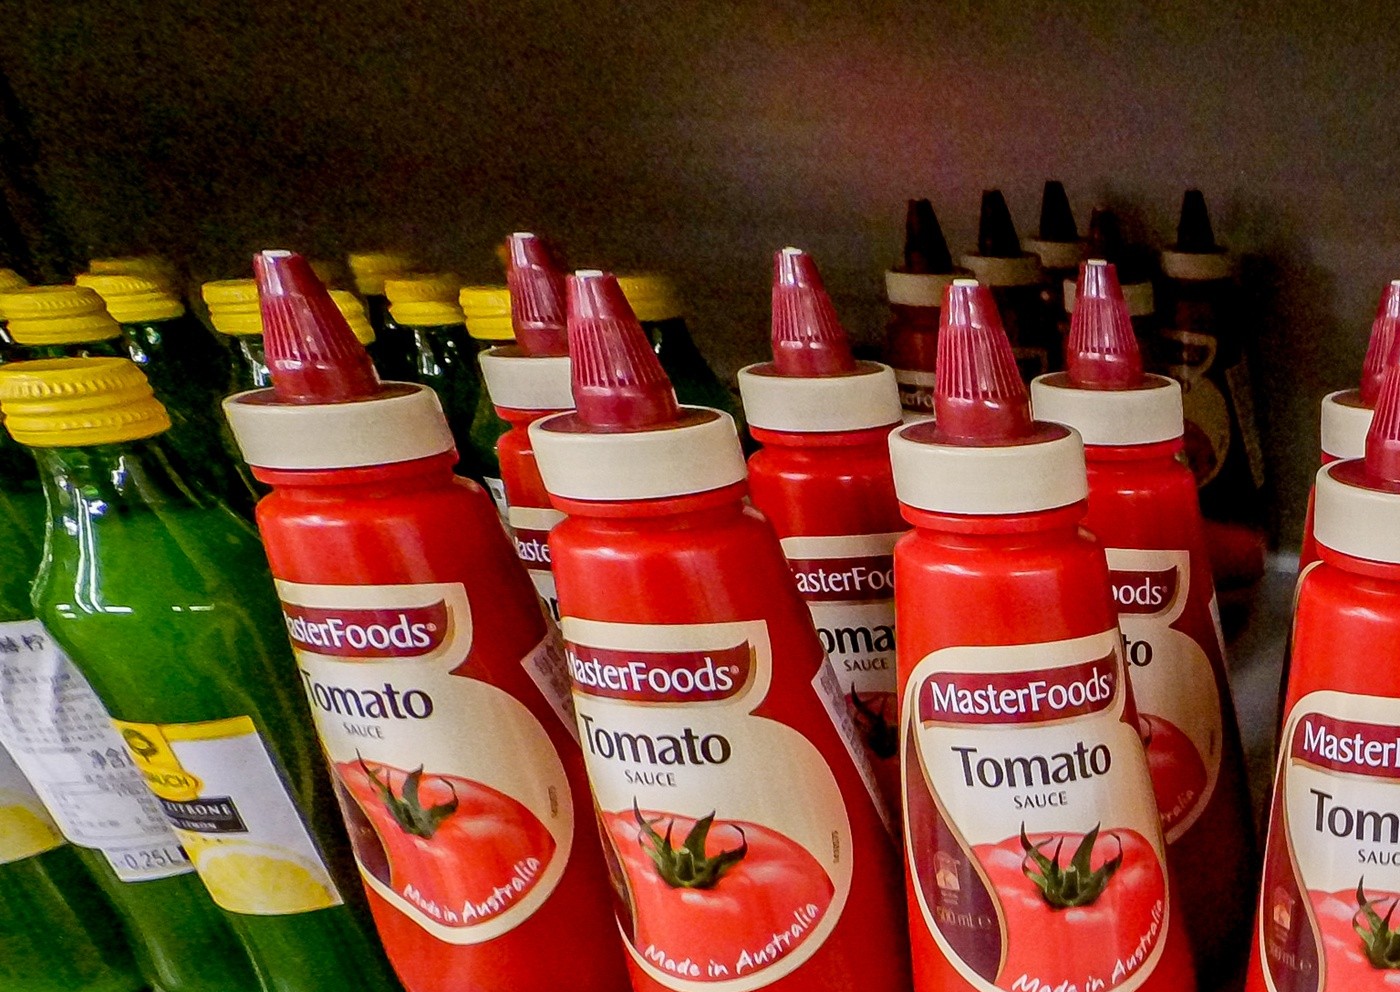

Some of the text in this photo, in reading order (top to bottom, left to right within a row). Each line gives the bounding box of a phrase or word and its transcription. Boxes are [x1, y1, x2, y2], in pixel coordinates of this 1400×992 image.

[515, 536, 551, 562] aste
[791, 567, 894, 592] asterFo
[284, 615, 431, 649] asterFoods
[844, 658, 888, 671] SAUCE
[300, 668, 435, 719] Tomato
[931, 671, 1110, 716] MasterFoods
[343, 723, 384, 739] SAUCE
[580, 712, 732, 766] Tomato
[624, 769, 677, 787] SAUCE
[951, 742, 1112, 789] Tomato
[1013, 791, 1069, 810] SAUCE
[404, 883, 442, 920] Made
[462, 857, 541, 923] Australia
[645, 903, 819, 977] Made in Australia
[1085, 975, 1106, 991] in
[1111, 899, 1164, 985] Australia
